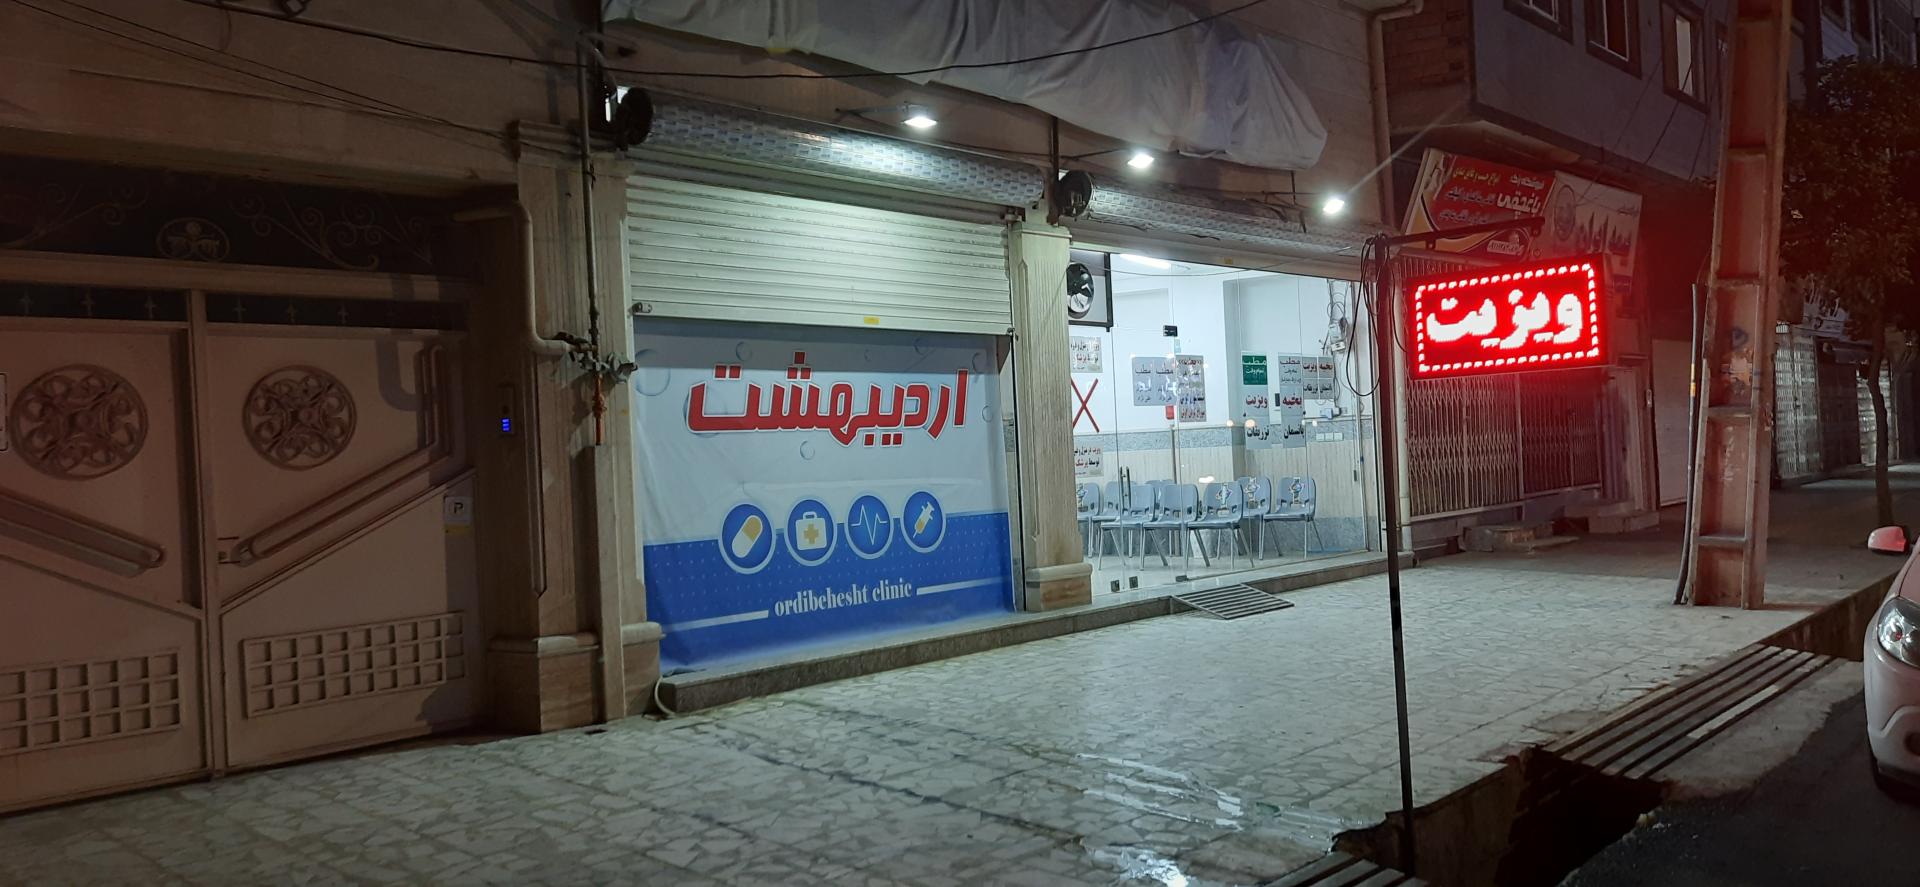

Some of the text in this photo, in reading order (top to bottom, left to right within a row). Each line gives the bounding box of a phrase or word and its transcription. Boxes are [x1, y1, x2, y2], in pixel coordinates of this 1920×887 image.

[1426, 289, 1584, 350] ویزیت
[1241, 357, 1267, 367] مطب
[1280, 357, 1301, 368] مطب
[686, 351, 970, 448] اردیبهشت
[1246, 394, 1268, 409] ویزیت
[1282, 393, 1302, 408] بخیه
[1246, 425, 1269, 441] تزریقات
[1284, 424, 1304, 440] پانسمان
[454, 502, 464, 514] P
[872, 577, 914, 604] clinic
